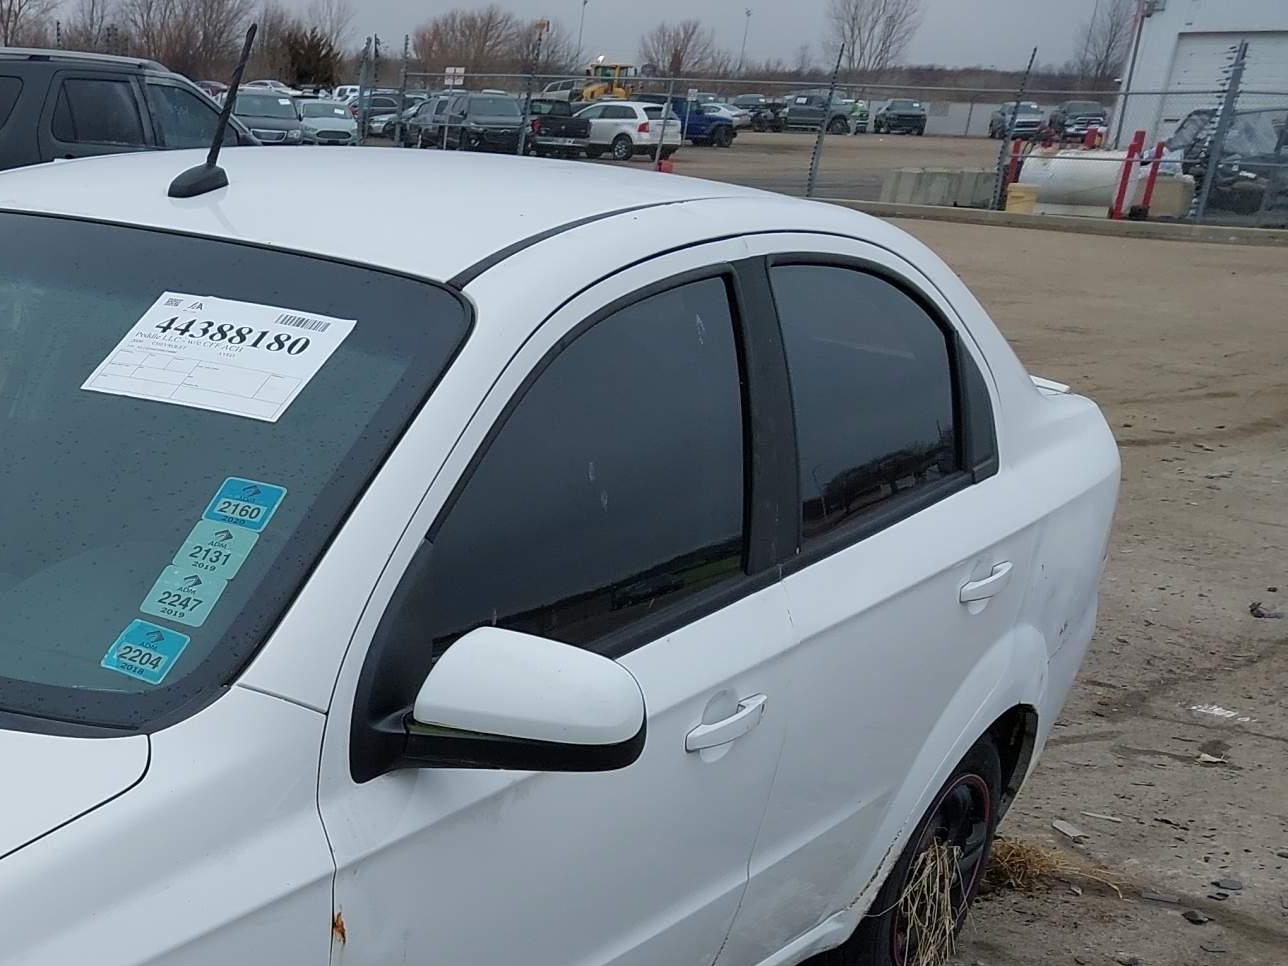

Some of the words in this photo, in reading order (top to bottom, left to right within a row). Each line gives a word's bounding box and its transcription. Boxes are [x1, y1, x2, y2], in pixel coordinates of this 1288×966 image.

[155, 316, 311, 356] 44388180
[217, 501, 261, 519] 2160
[221, 515, 246, 525] 2020
[188, 545, 232, 565] 2131
[191, 560, 216, 571] 2019
[157, 591, 203, 611] 2247
[159, 607, 185, 618] 2019
[118, 645, 163, 669] 2204
[119, 662, 145, 675] 2018
